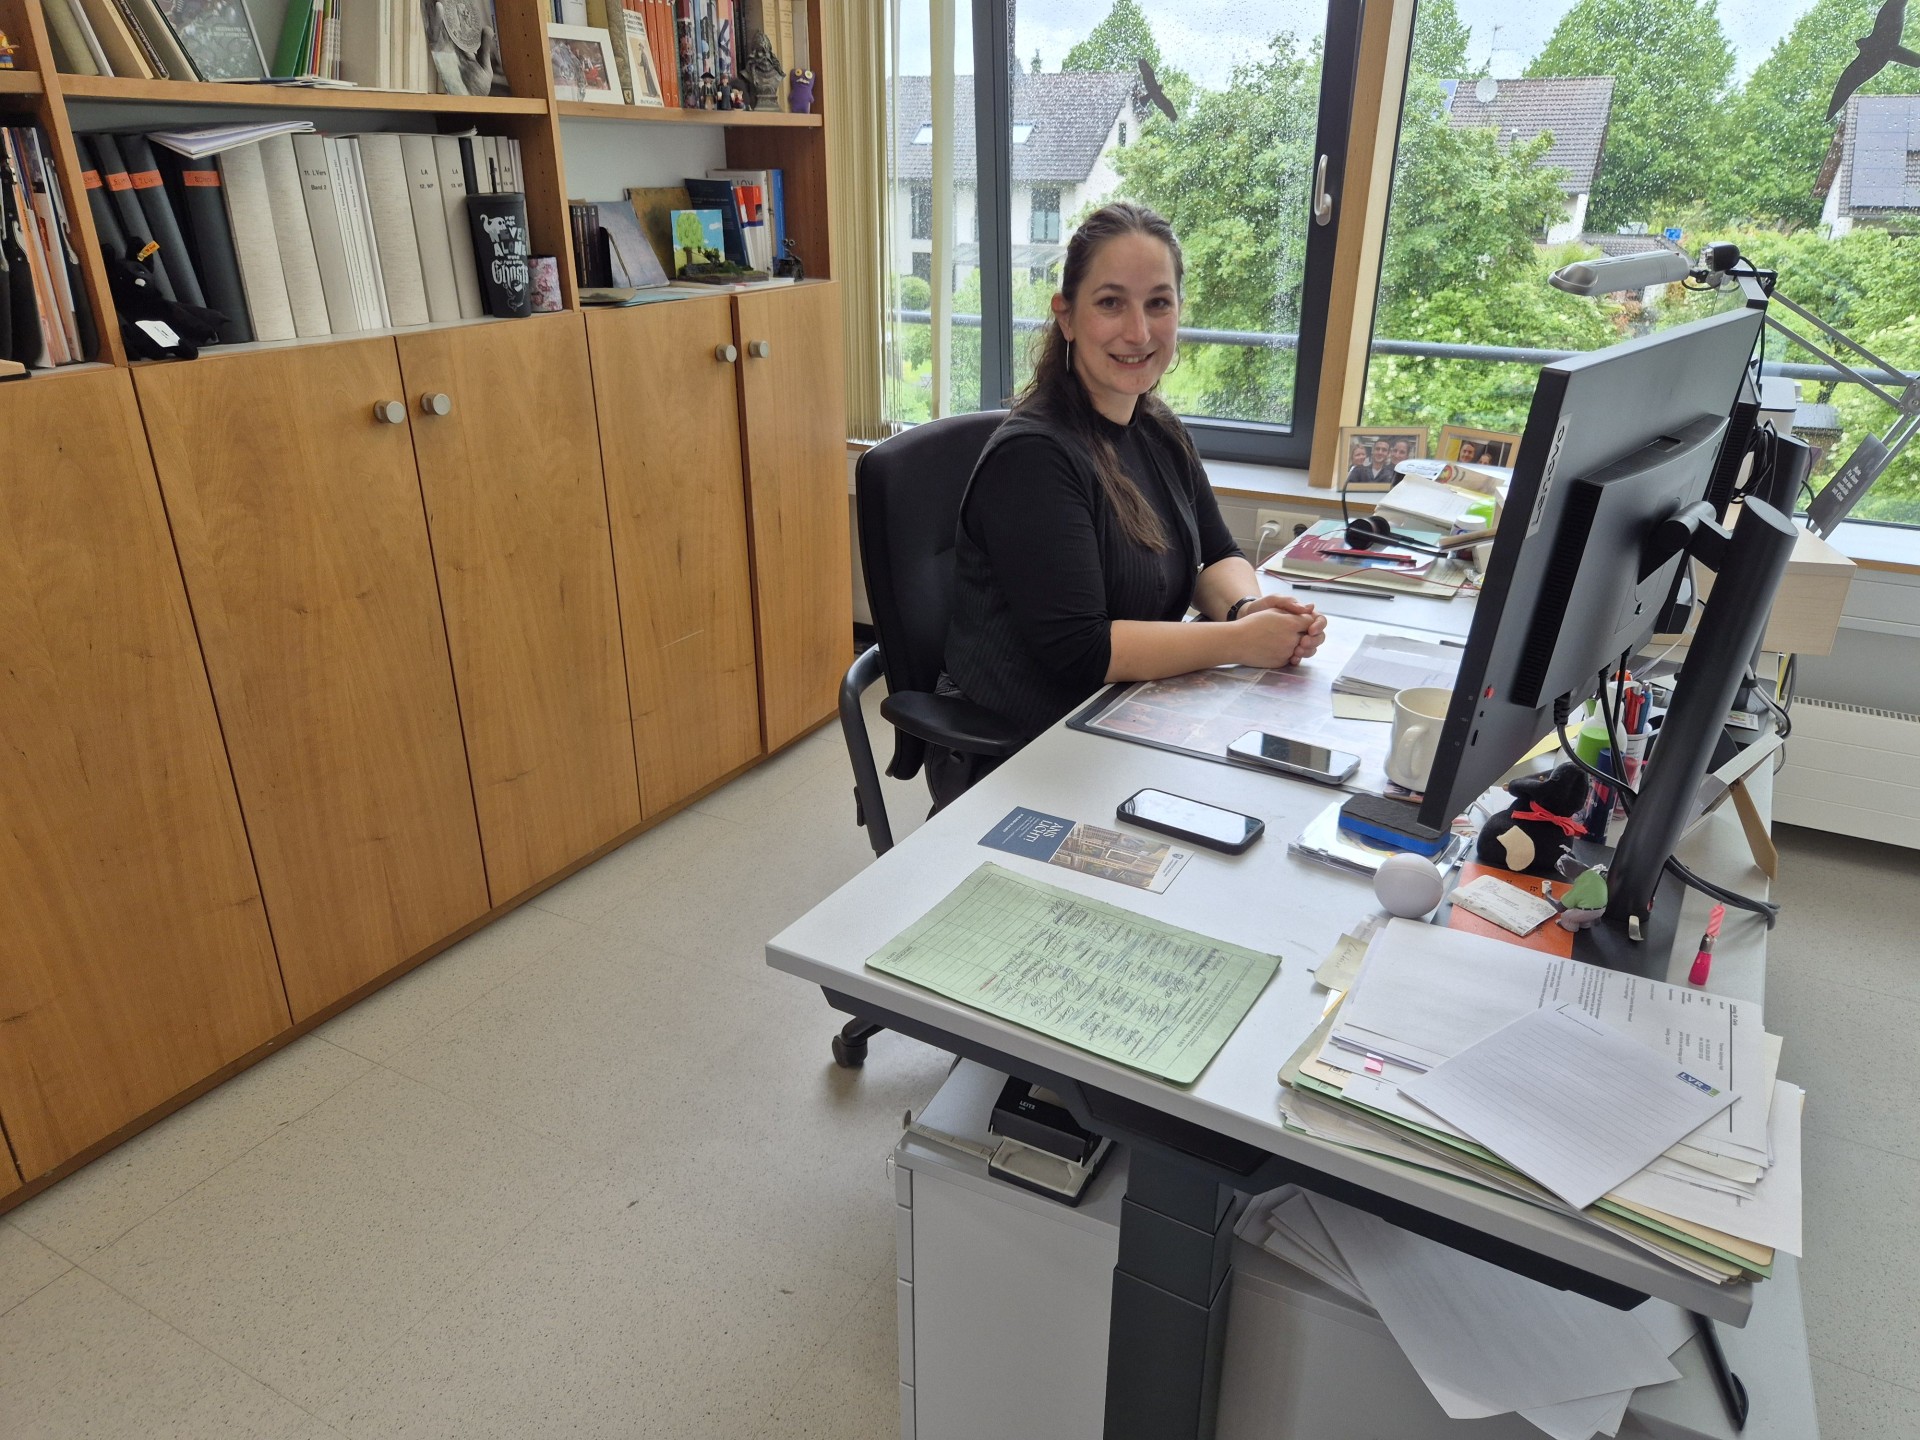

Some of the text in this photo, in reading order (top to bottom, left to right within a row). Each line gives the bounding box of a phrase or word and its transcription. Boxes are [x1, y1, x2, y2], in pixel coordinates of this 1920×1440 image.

[494, 241, 526, 256] ALONE
[1023, 819, 1053, 843] LICHT!
[1043, 822, 1064, 838] ANS
[1680, 1072, 1705, 1088] LVR
[1019, 1100, 1035, 1110] LEITZ
